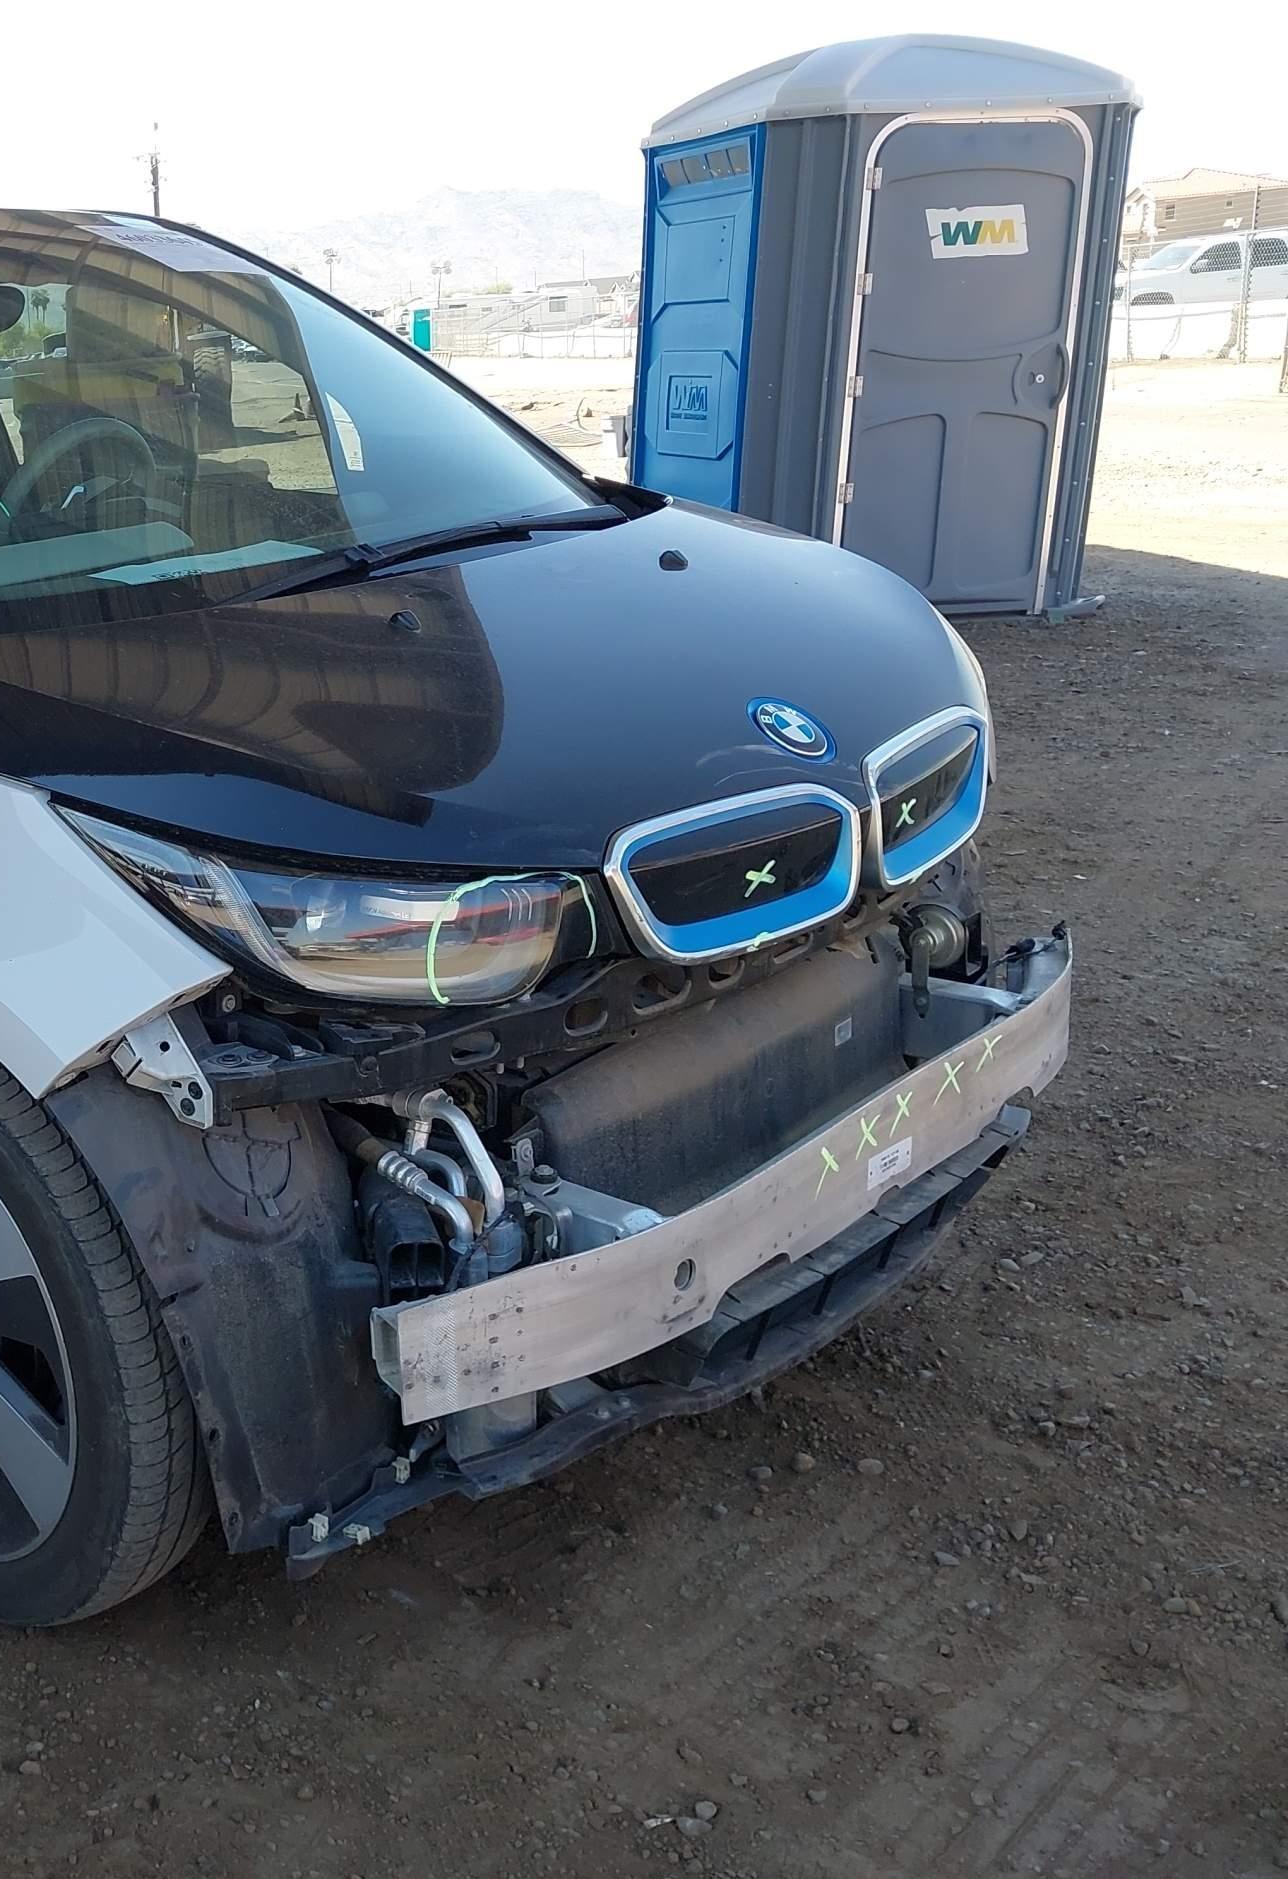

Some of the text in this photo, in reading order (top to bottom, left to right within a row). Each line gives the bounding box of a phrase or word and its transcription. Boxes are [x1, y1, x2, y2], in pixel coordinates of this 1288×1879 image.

[940, 219, 1016, 246] WM
[672, 384, 708, 411] WM
[760, 704, 798, 724] BMW
